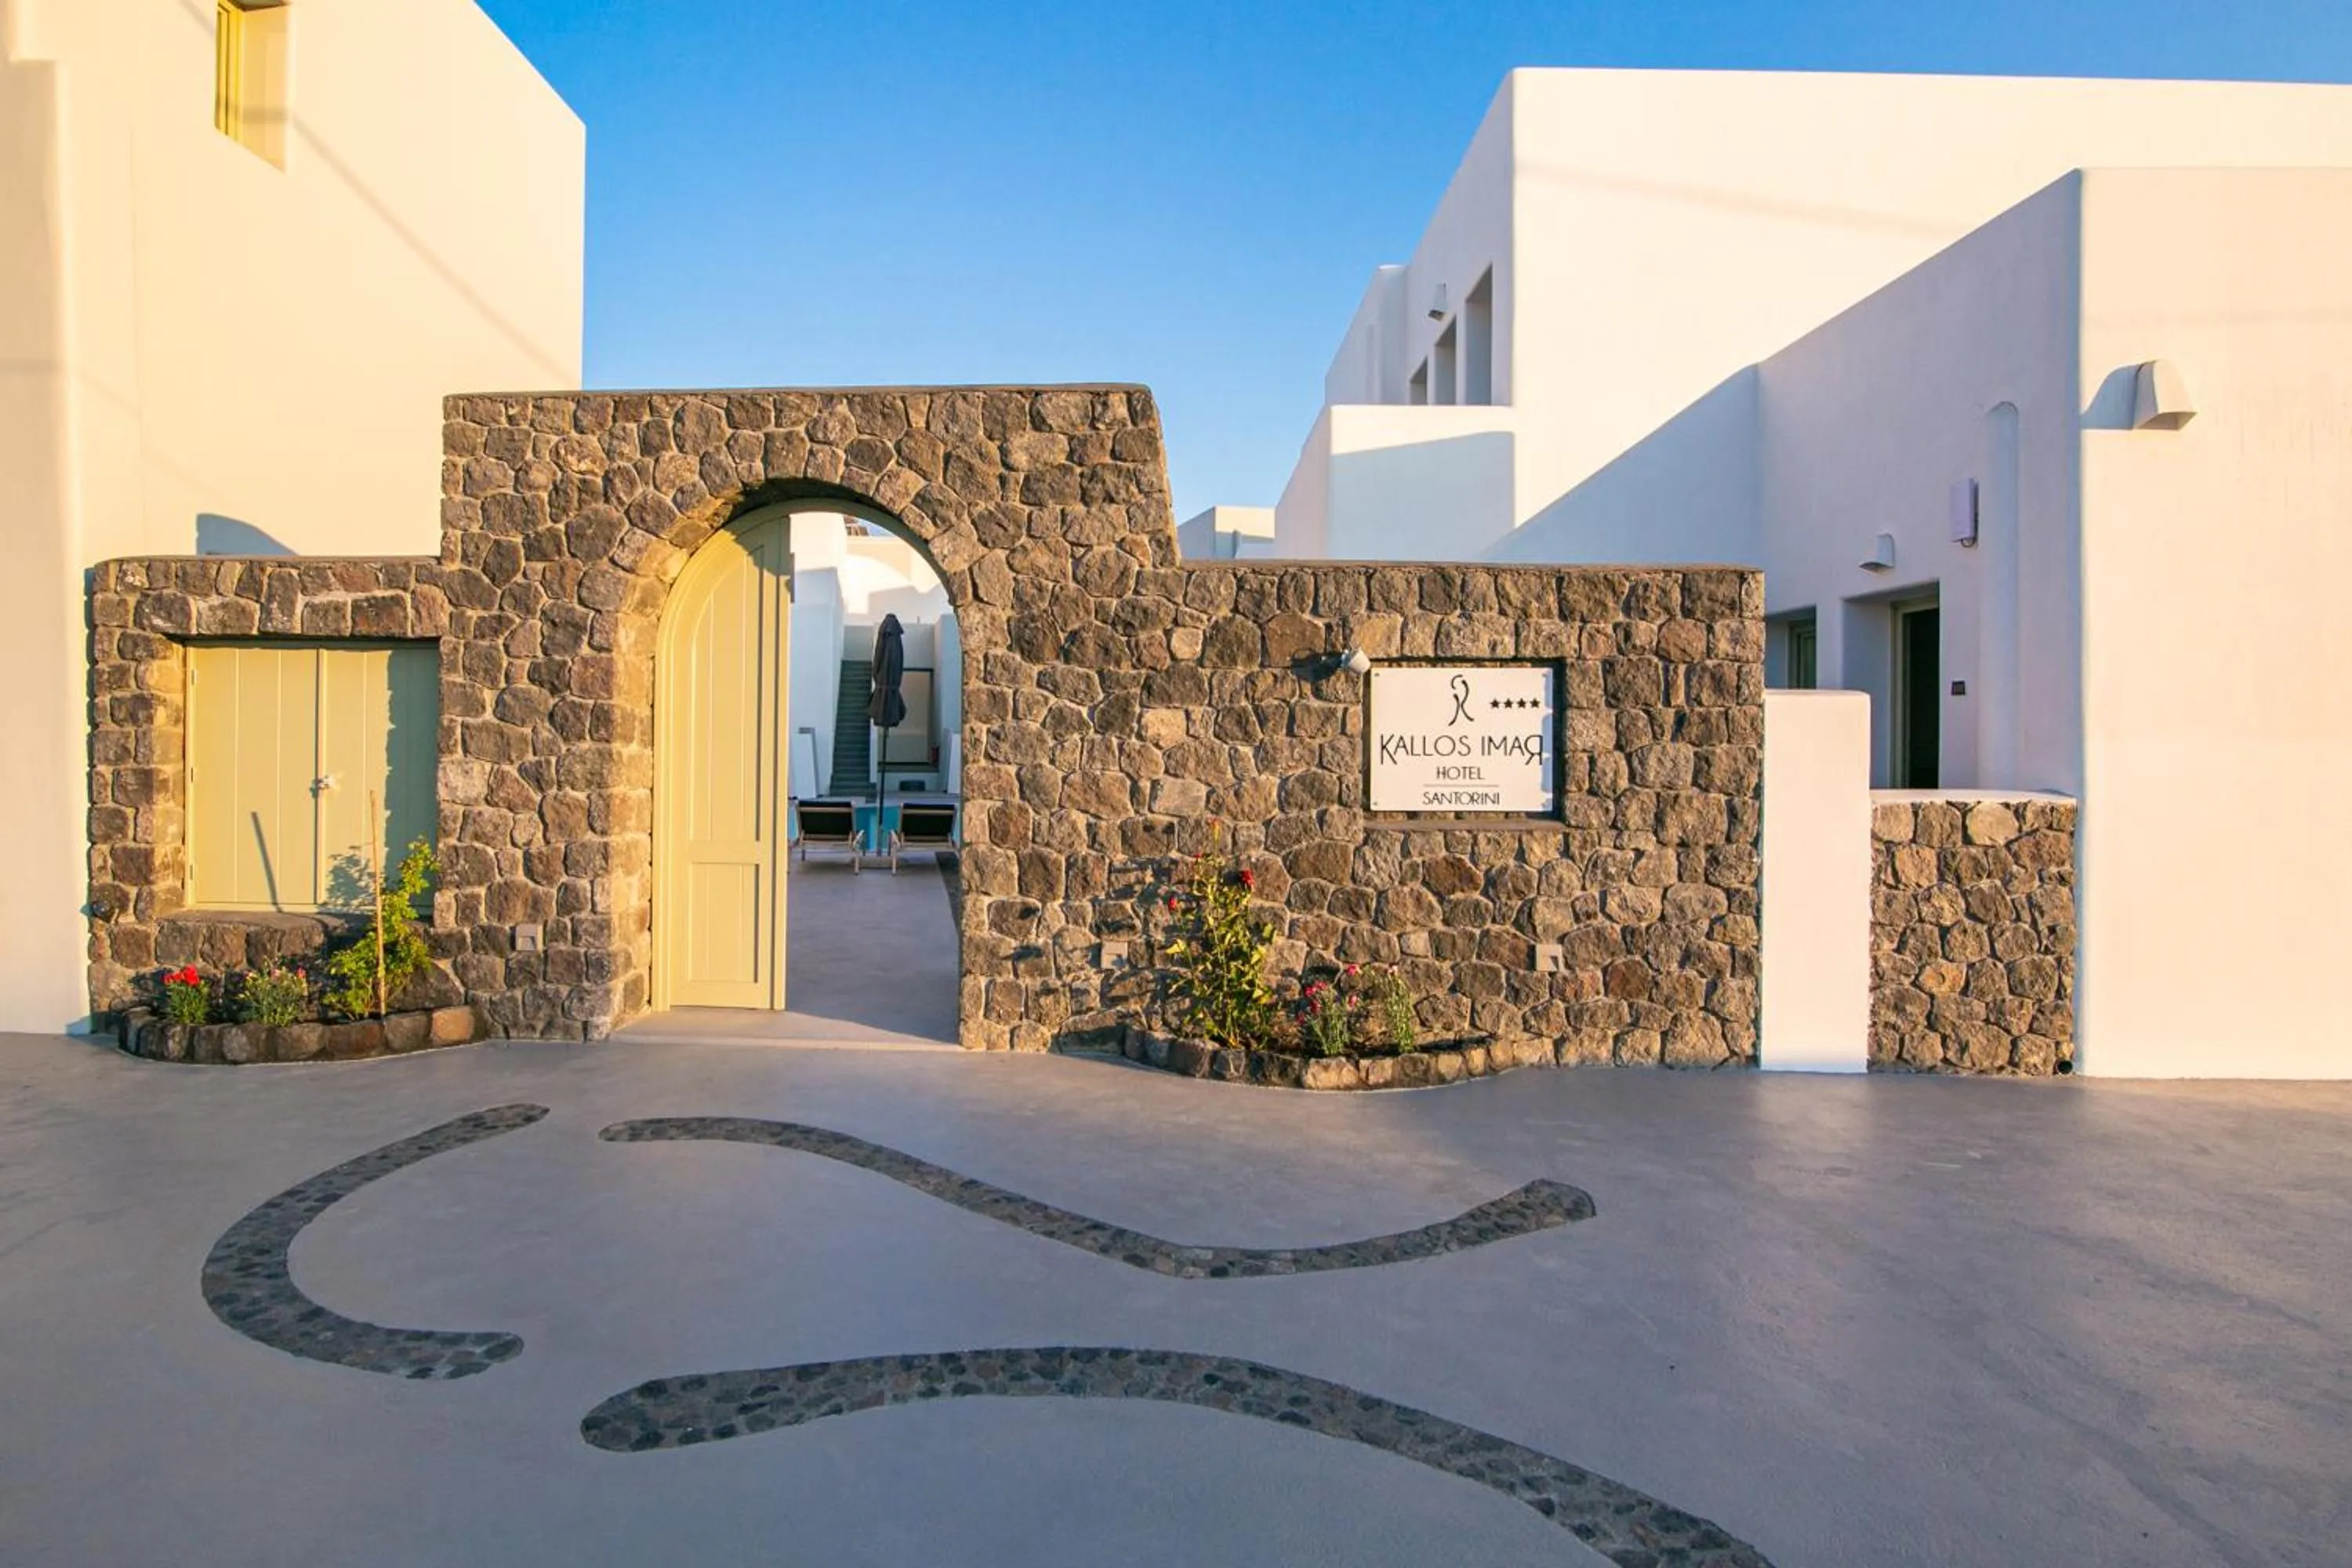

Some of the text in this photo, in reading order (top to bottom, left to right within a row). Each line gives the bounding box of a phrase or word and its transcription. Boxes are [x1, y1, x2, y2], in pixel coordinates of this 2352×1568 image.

[1380, 734, 1471, 765] KALLOS
[1436, 766, 1485, 780] HOTEL
[1422, 791, 1500, 805] SANTORINI
